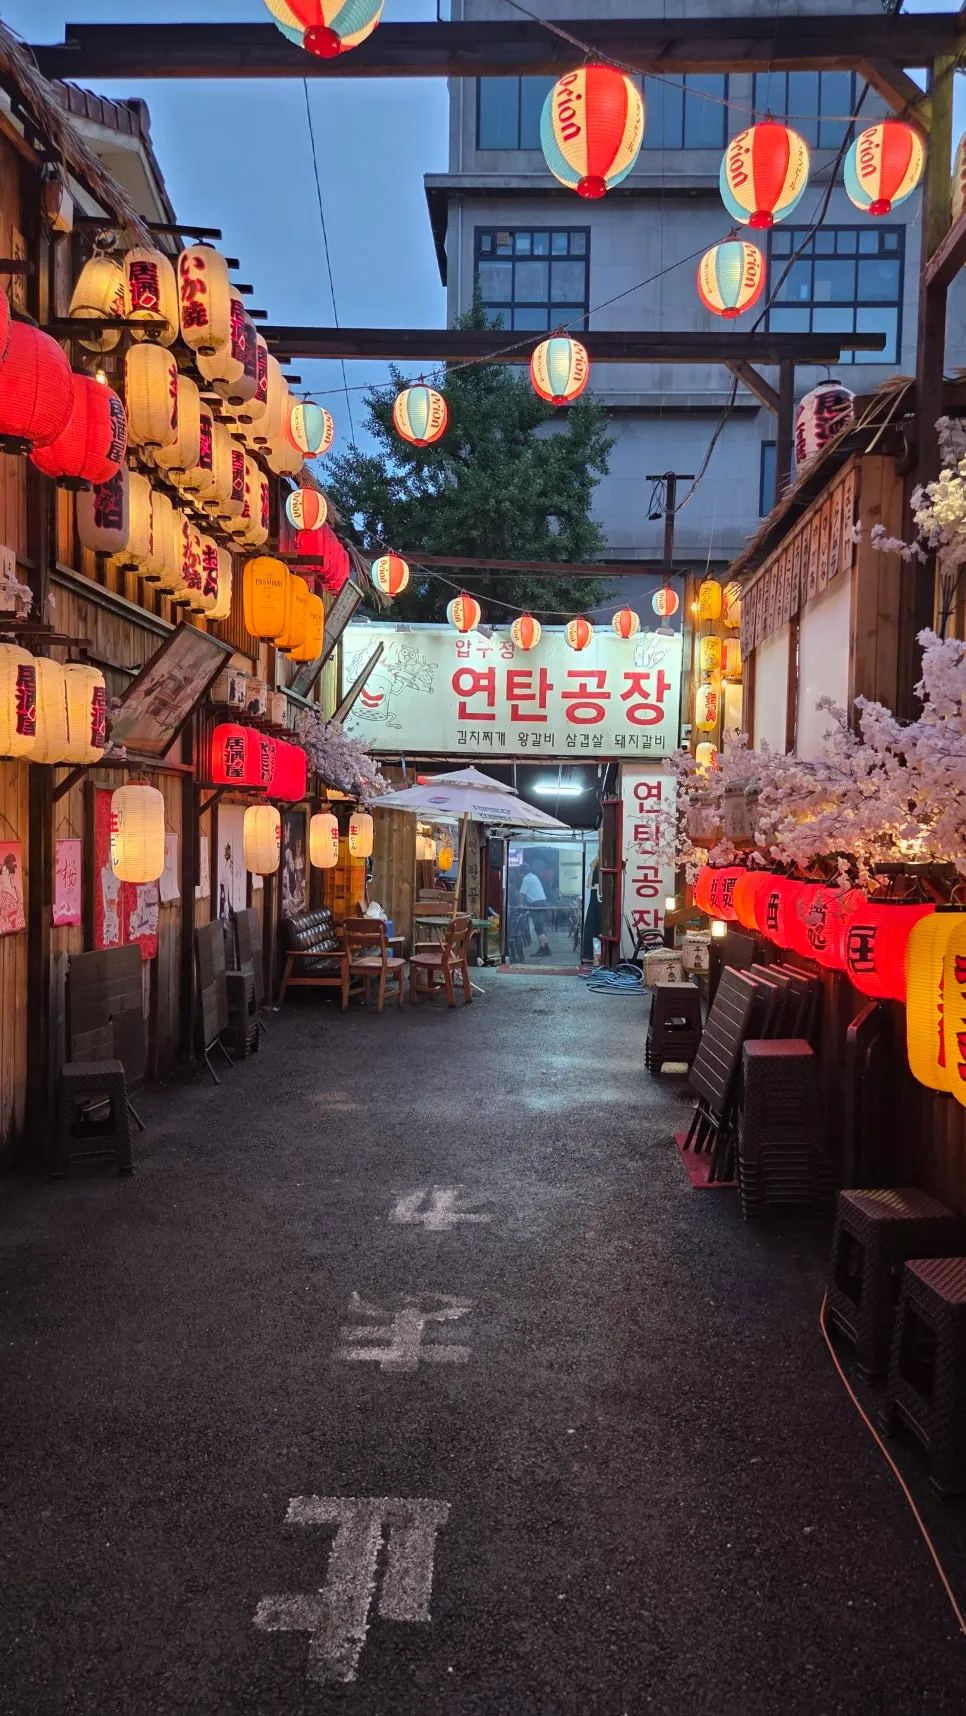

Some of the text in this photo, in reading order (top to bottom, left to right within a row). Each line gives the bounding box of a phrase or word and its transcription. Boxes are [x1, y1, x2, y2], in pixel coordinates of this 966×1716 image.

[557, 73, 582, 143] Orion
[728, 130, 750, 189] Orion
[859, 128, 880, 178] Orion
[744, 244, 760, 289] Orion
[129, 261, 159, 311] 居酒
[574, 343, 586, 382] Orion
[323, 410, 334, 444] Orion
[431, 393, 445, 428] Orion
[292, 492, 302, 519] Orion
[379, 559, 389, 584] Orion
[453, 600, 462, 623] Orion
[658, 592, 666, 610] Orion
[455, 639, 516, 660] 압구정
[568, 623, 576, 643] Orion
[451, 665, 671, 726] 연탄공장
[224, 736, 245, 778] 居酒屋
[456, 730, 666, 749] 김치찌개 왕갈비 삼겹살 돼지갈비
[467, 840, 479, 919] 연탄공
